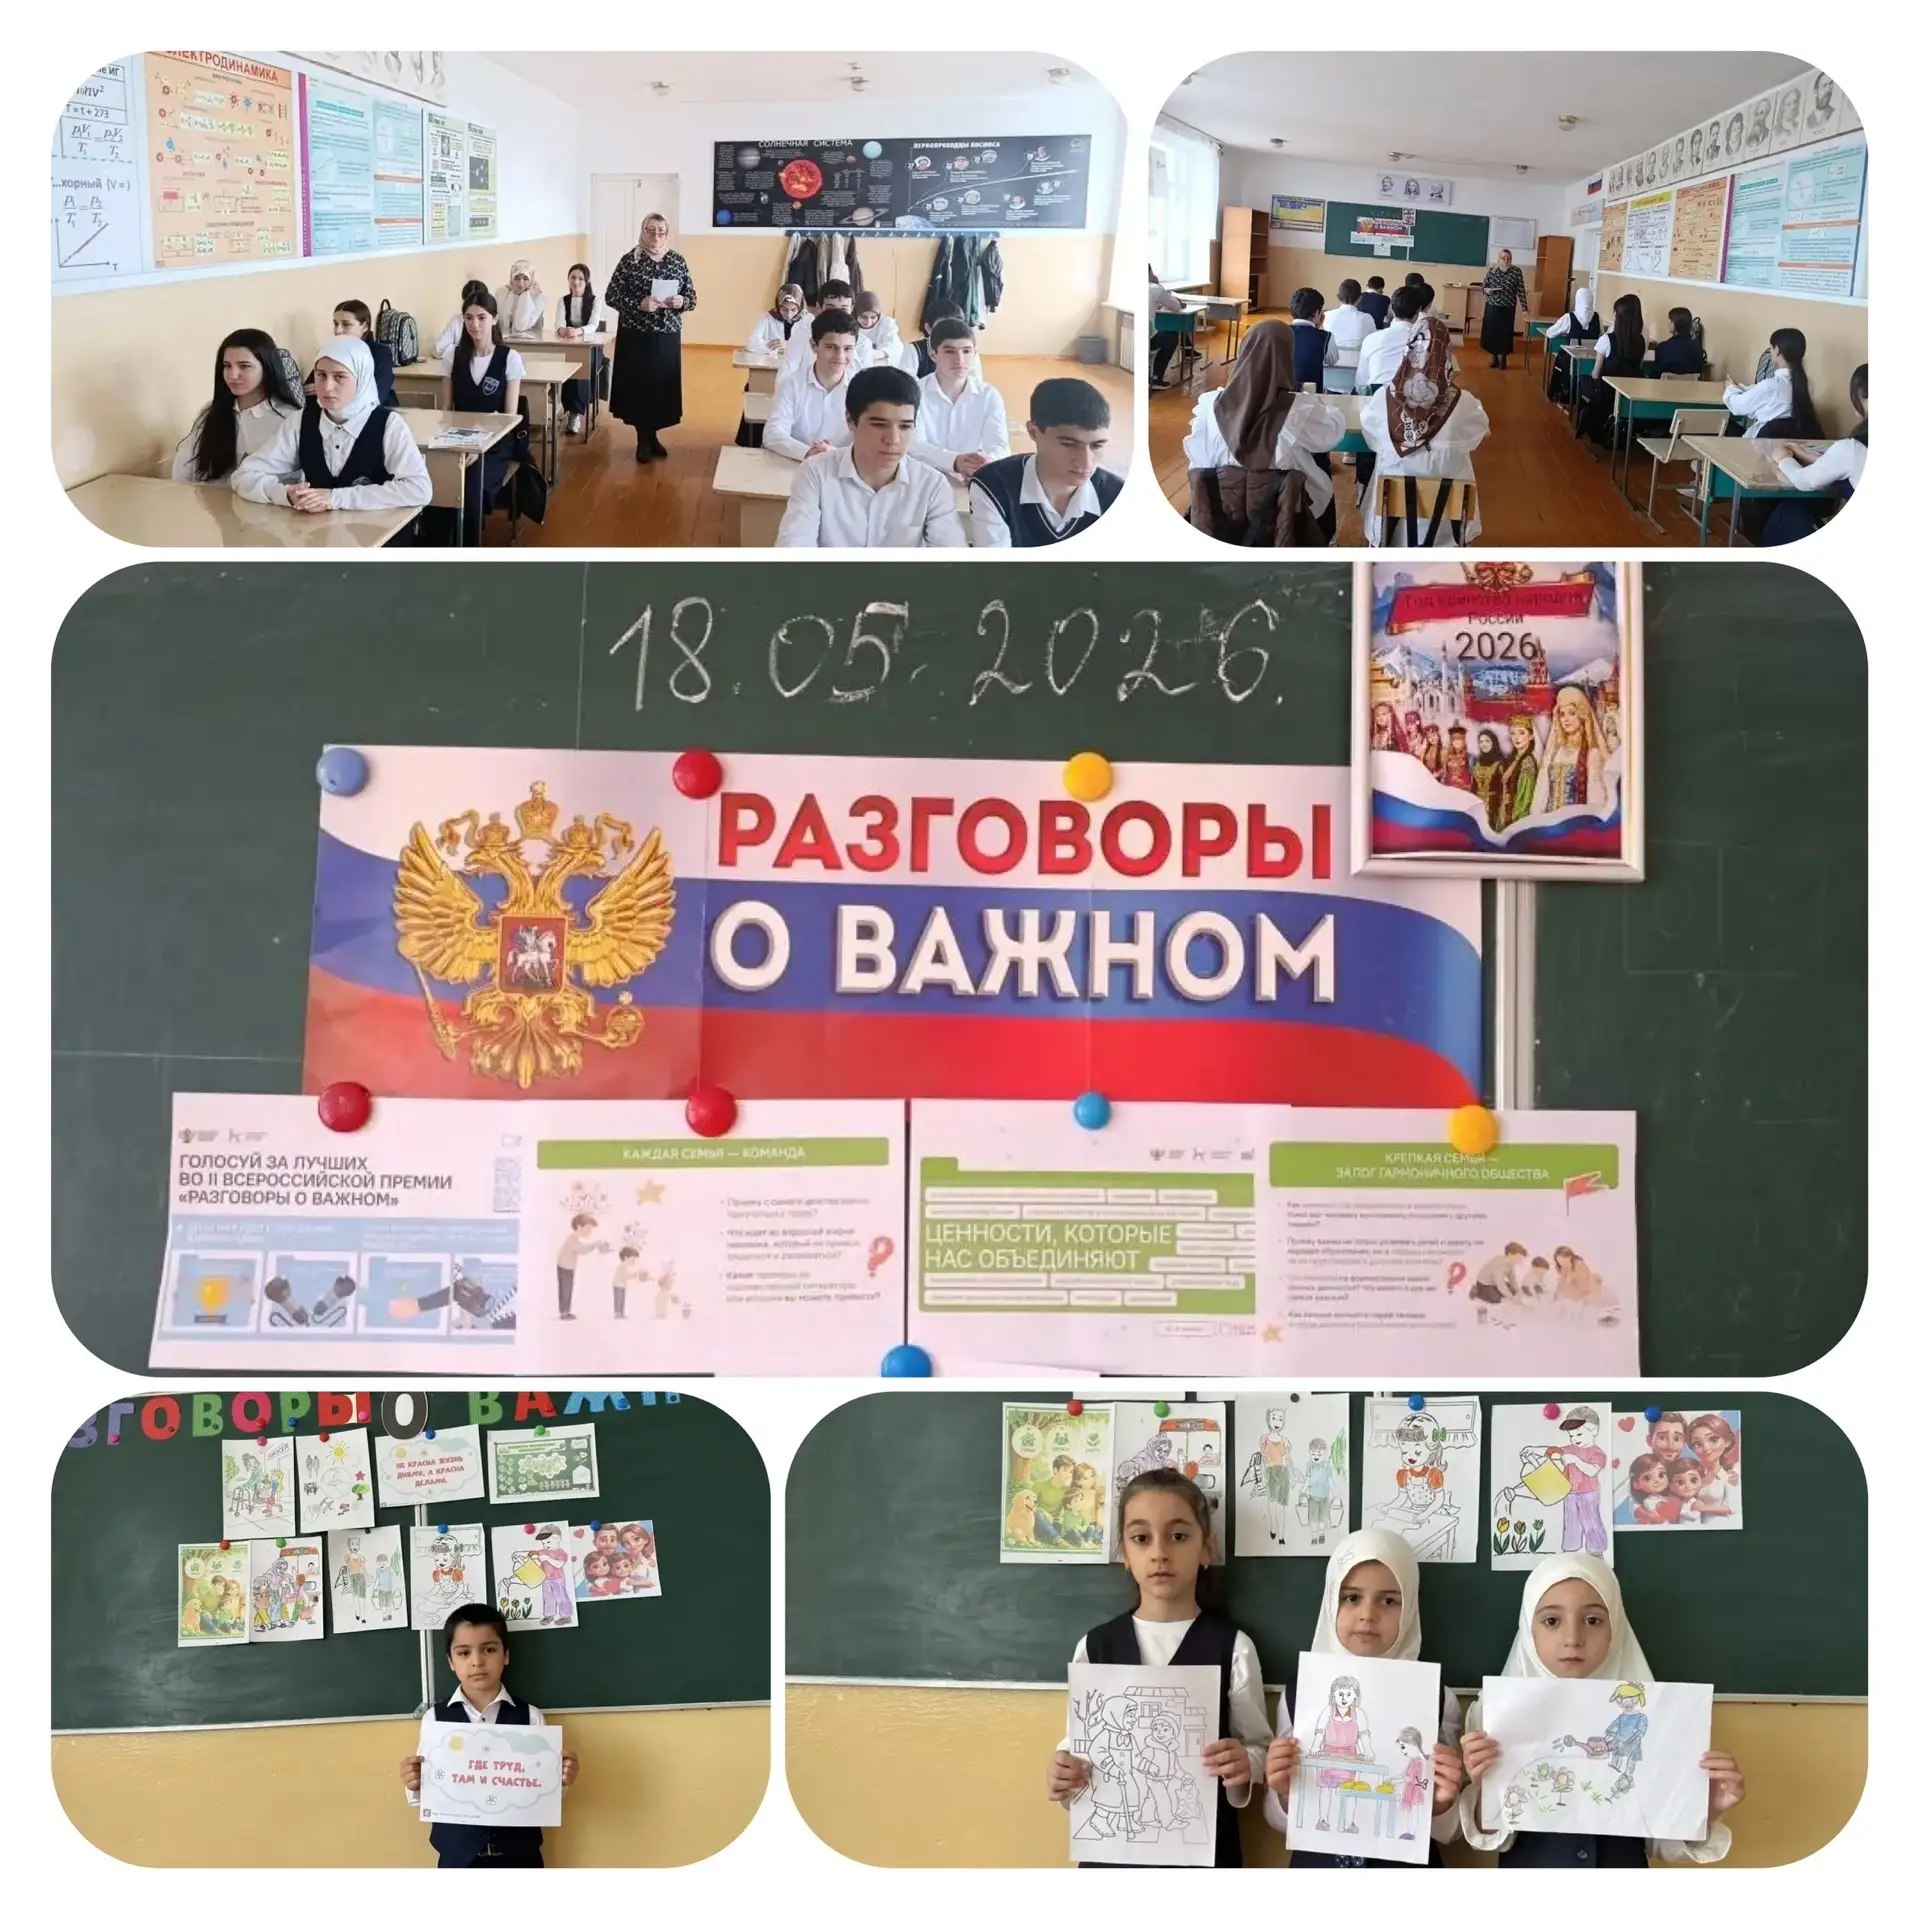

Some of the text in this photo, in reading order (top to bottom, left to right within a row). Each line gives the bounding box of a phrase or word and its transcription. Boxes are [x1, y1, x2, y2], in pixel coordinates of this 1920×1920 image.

[166, 51, 279, 83] ЛЕКТРОДИНАМИКА
[94, 108, 109, 119] 273
[758, 139, 853, 148] СОЛНЕЧНАЯ СИСТЕМА
[1468, 613, 1524, 626] России
[1456, 632, 1538, 660] 2026
[718, 792, 1331, 879] РАЗГОВОРЫ
[710, 900, 1335, 1003] О ВАЖНОМ
[623, 1149, 679, 1161] КАЖДАЯ
[681, 1148, 724, 1160] СЕМЬЯ
[742, 1147, 806, 1159] КОМАНДА
[1385, 1153, 1442, 1164] КРЕПКАЯ
[179, 1153, 368, 1171] ГОЛОСУЙ ЗА ЛУЧШИХ
[179, 1172, 203, 1186] ВО
[223, 1171, 375, 1188] ВСЕРОССИЙСКОЙ
[380, 1175, 452, 1189] ПРЕМИИ
[1336, 1167, 1549, 1181] ЗАЛОГ ГАРМОНИЧНОГО ОБЩЕСТВА
[179, 1190, 399, 1206] «РАЗГОВОРЫ О ВАЖНОМ»
[925, 1224, 1172, 1245] ЦЕННОСТИ, КОТОРЫЕ
[925, 1249, 1141, 1272] НАС ОБЪЕДИНЯЮТ
[407, 1460, 436, 1469] КРАСНА
[436, 1465, 464, 1475] КРАСНА
[468, 1760, 525, 1774] ГДЕ ТРУД,
[452, 1774, 542, 1788] ТАМ И СЧАСТЬЕ.
